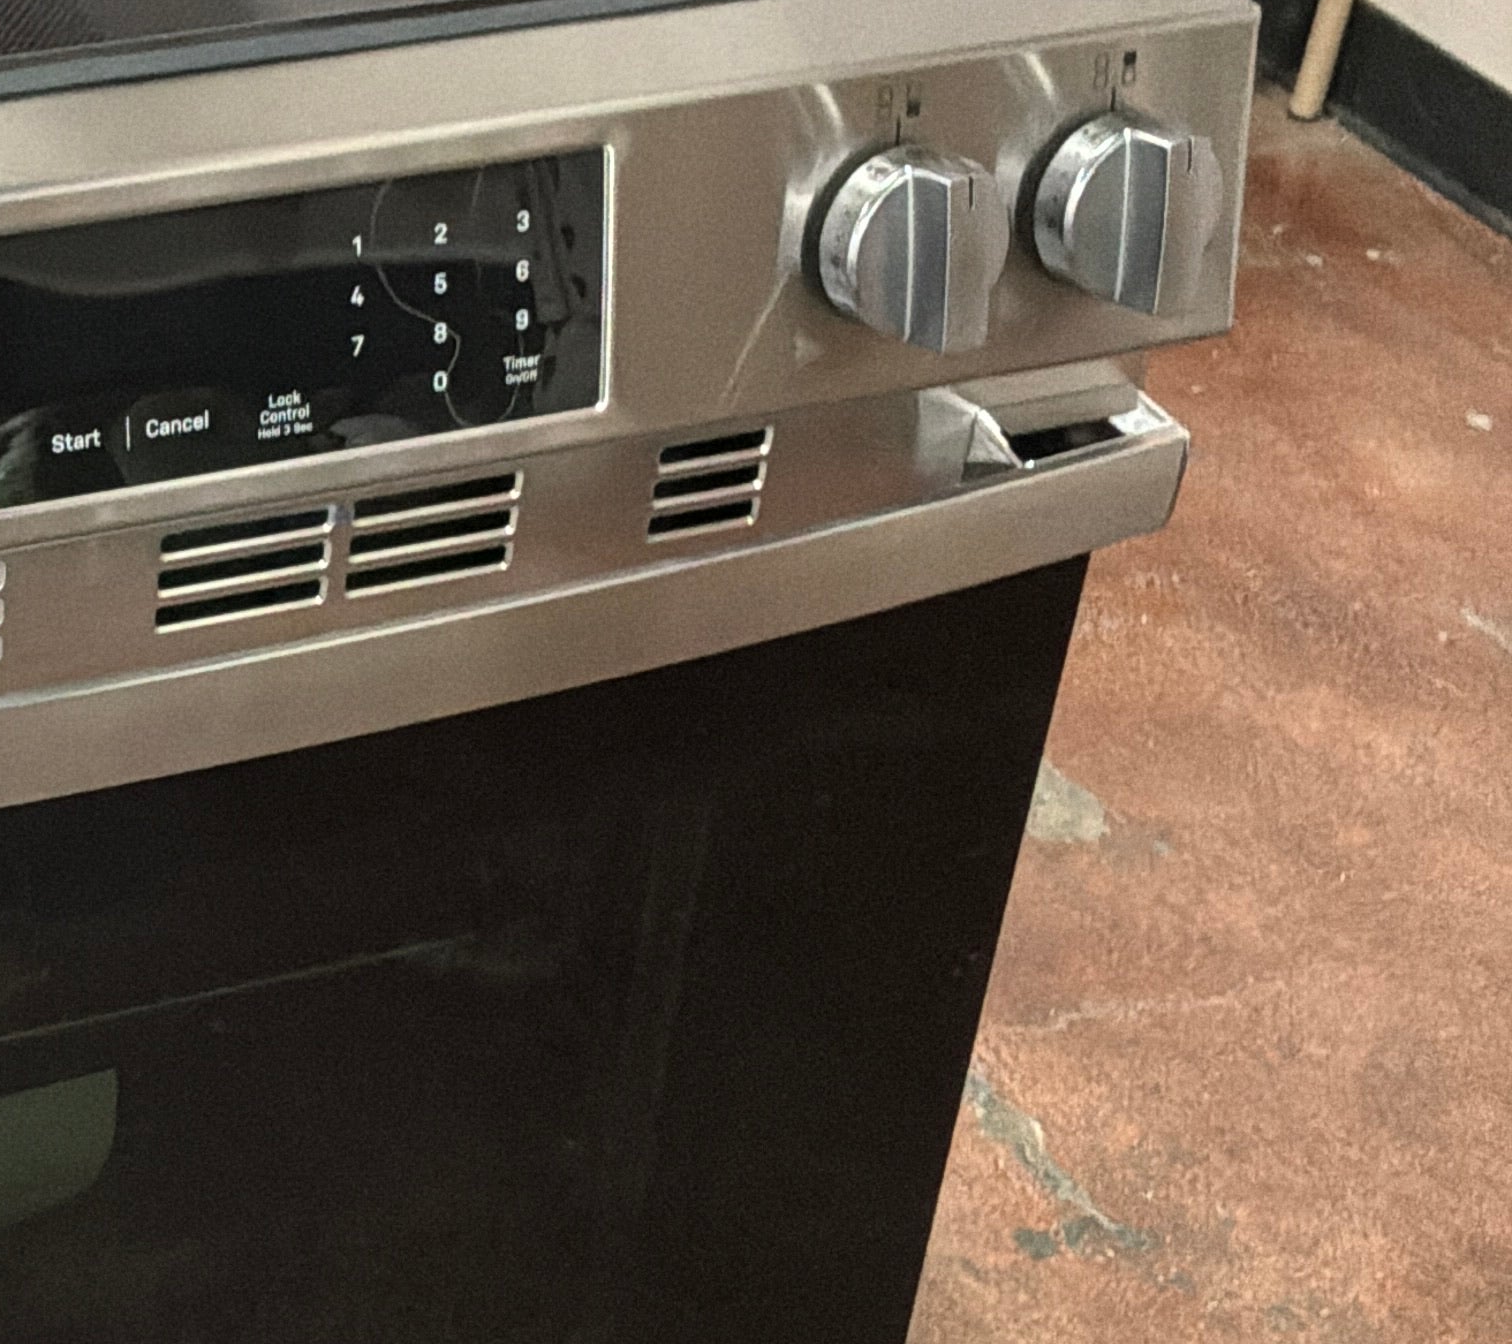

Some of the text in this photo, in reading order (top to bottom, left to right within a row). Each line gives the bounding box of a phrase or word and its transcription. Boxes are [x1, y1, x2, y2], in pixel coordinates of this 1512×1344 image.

[516, 209, 530, 232] 3
[434, 222, 448, 244] 2
[352, 234, 362, 257] 1
[516, 259, 529, 282] 6
[434, 272, 447, 295] 5
[350, 285, 365, 307] 4
[515, 308, 529, 331] 9
[433, 322, 447, 344] 8
[351, 334, 365, 357] 7
[502, 354, 541, 372] Timer
[433, 371, 448, 392] 0
[268, 389, 301, 409] Lock
[145, 409, 210, 439] Cancel
[259, 402, 310, 426] Control
[51, 428, 101, 454] Start
[283, 423, 291, 436] 3
